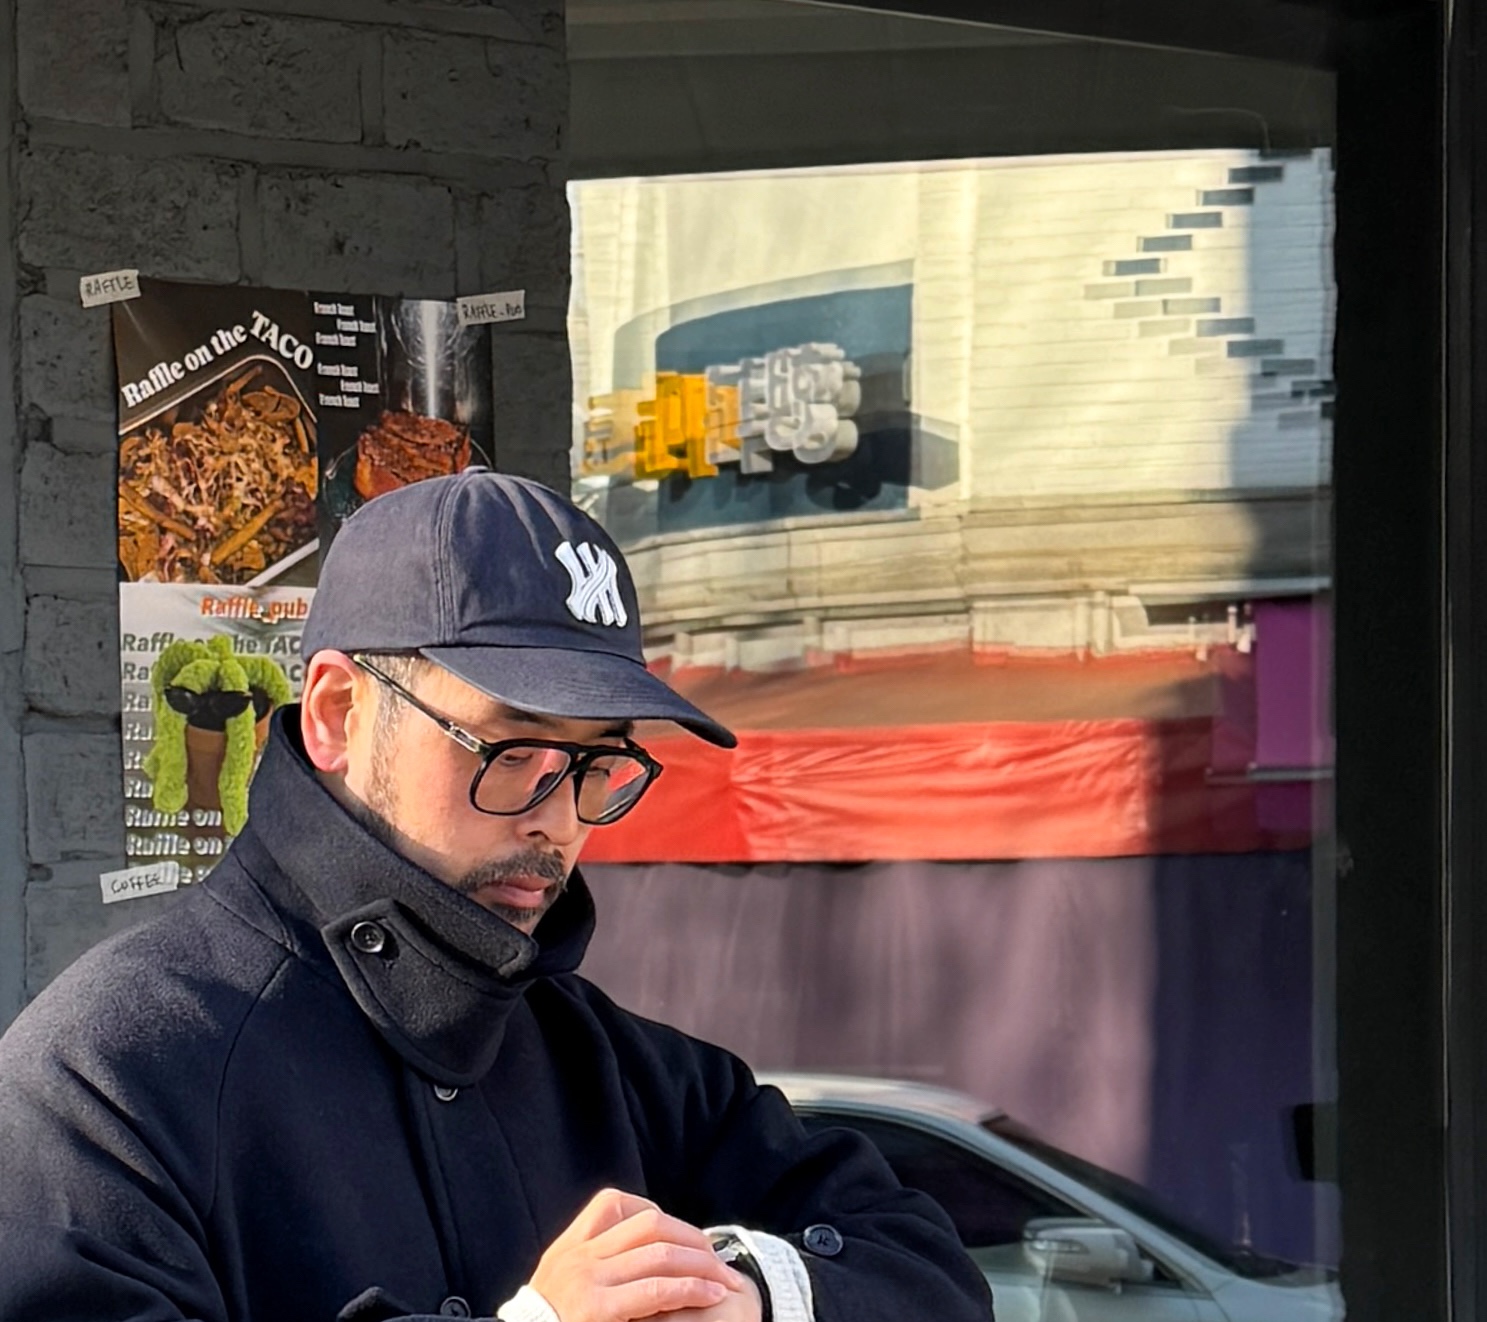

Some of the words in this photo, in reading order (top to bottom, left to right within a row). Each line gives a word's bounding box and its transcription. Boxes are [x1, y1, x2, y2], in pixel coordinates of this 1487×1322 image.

[121, 362, 186, 408] Raffle
[184, 345, 214, 371] on
[210, 324, 247, 355] the
[250, 310, 313, 369] TACO
[192, 808, 222, 827] on
[126, 832, 191, 856] Raffle
[193, 836, 223, 856] on
[112, 873, 161, 894] COFFEE
